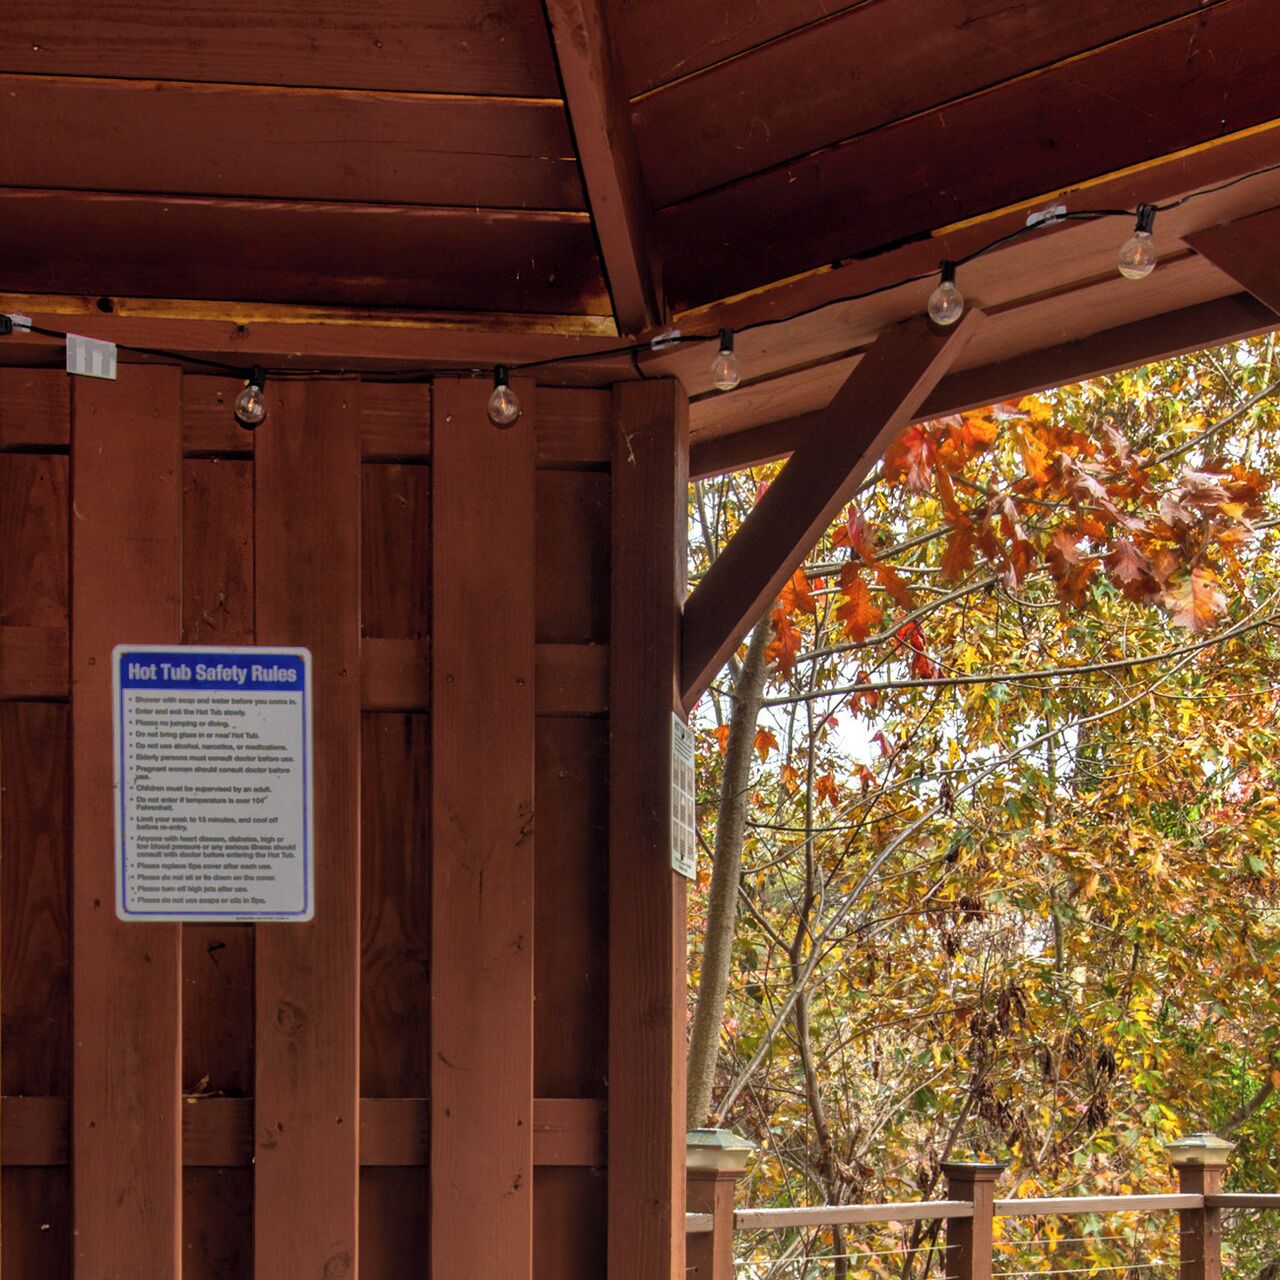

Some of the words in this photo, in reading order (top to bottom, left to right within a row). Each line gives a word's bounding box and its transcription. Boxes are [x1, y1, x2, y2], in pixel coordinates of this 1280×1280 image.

[127, 662, 157, 680] Hot
[159, 663, 192, 681] Tub
[195, 663, 248, 684] Safety
[251, 665, 297, 682] Rules
[207, 720, 229, 728] diving.
[178, 731, 197, 739] glass
[135, 765, 166, 773] Pregnant
[194, 785, 231, 793] supervised
[185, 796, 226, 804] temperature
[225, 851, 253, 859] entering
